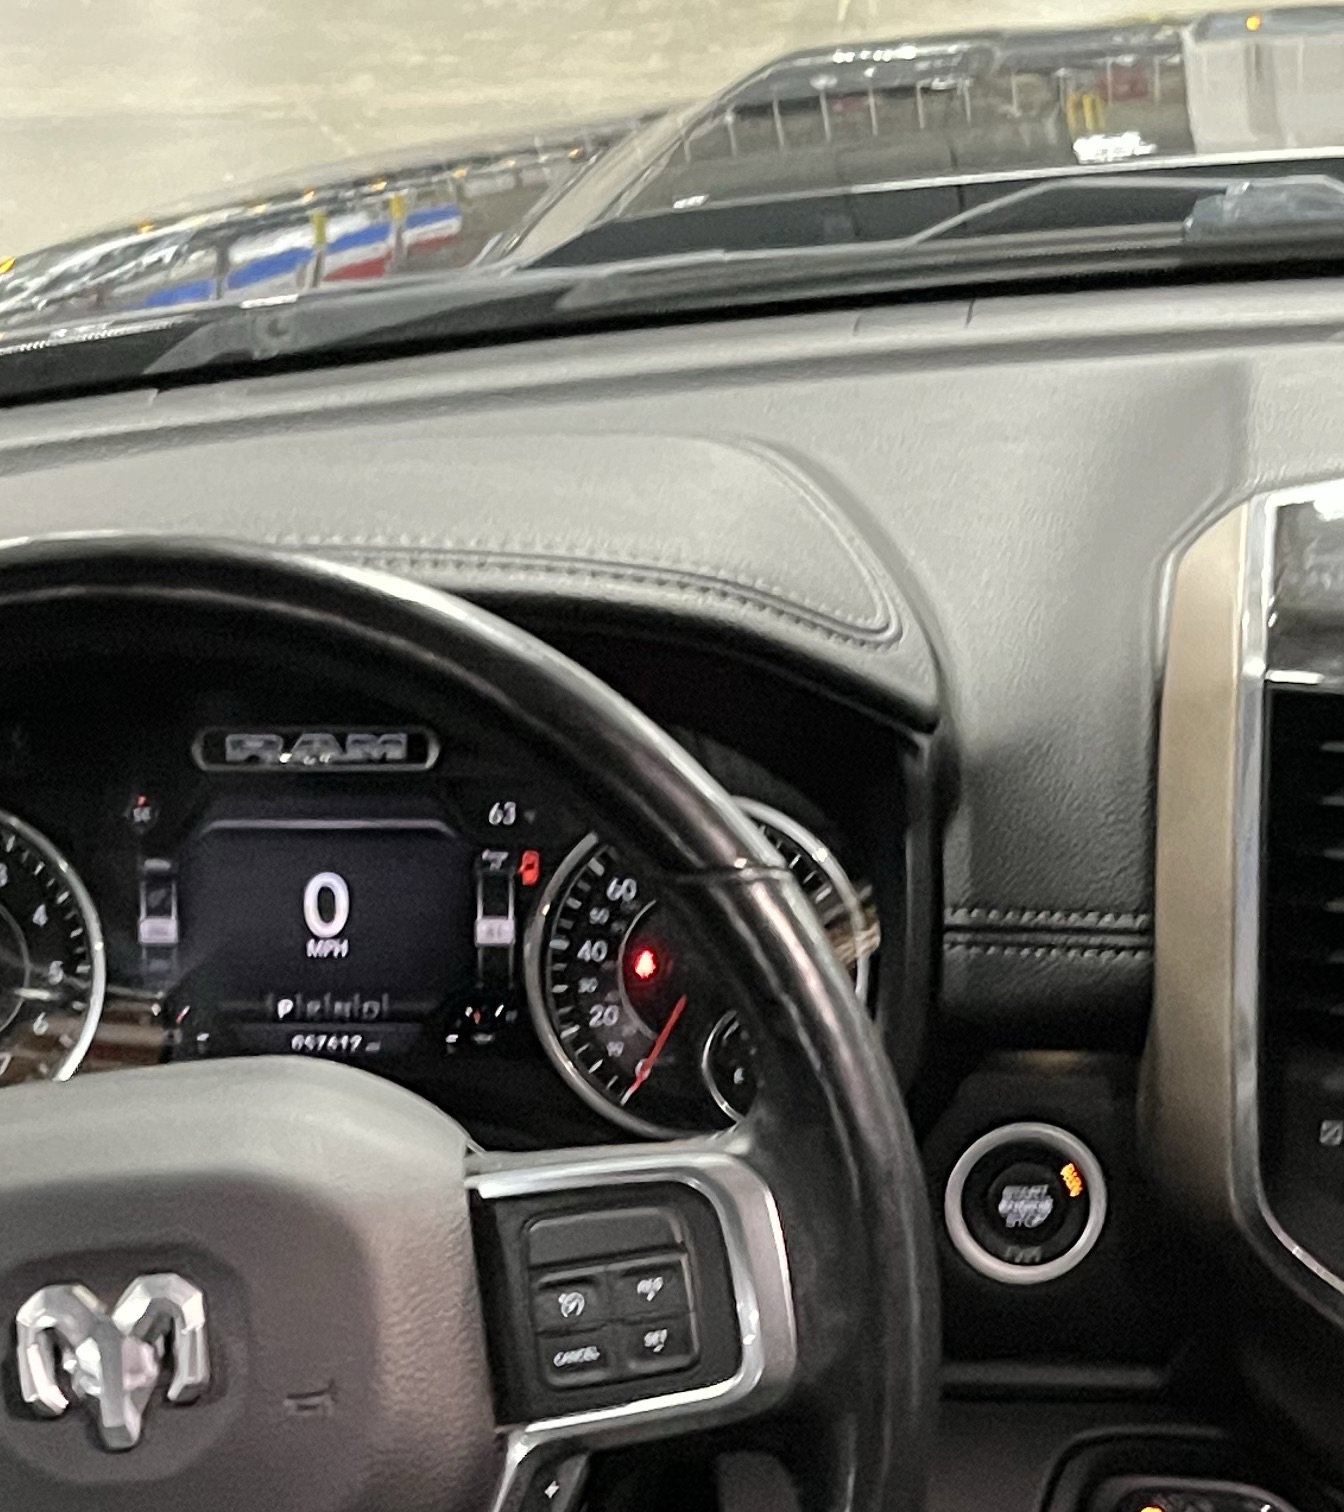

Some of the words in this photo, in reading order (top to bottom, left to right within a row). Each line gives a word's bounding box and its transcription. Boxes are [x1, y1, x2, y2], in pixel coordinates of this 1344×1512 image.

[224, 732, 408, 763] RAM
[606, 877, 638, 902] 60
[32, 903, 48, 927] 4
[303, 871, 350, 938] 0
[306, 938, 349, 959] MPH
[576, 939, 608, 963] 40
[32, 1012, 49, 1036] 6
[588, 1004, 620, 1028] 20
